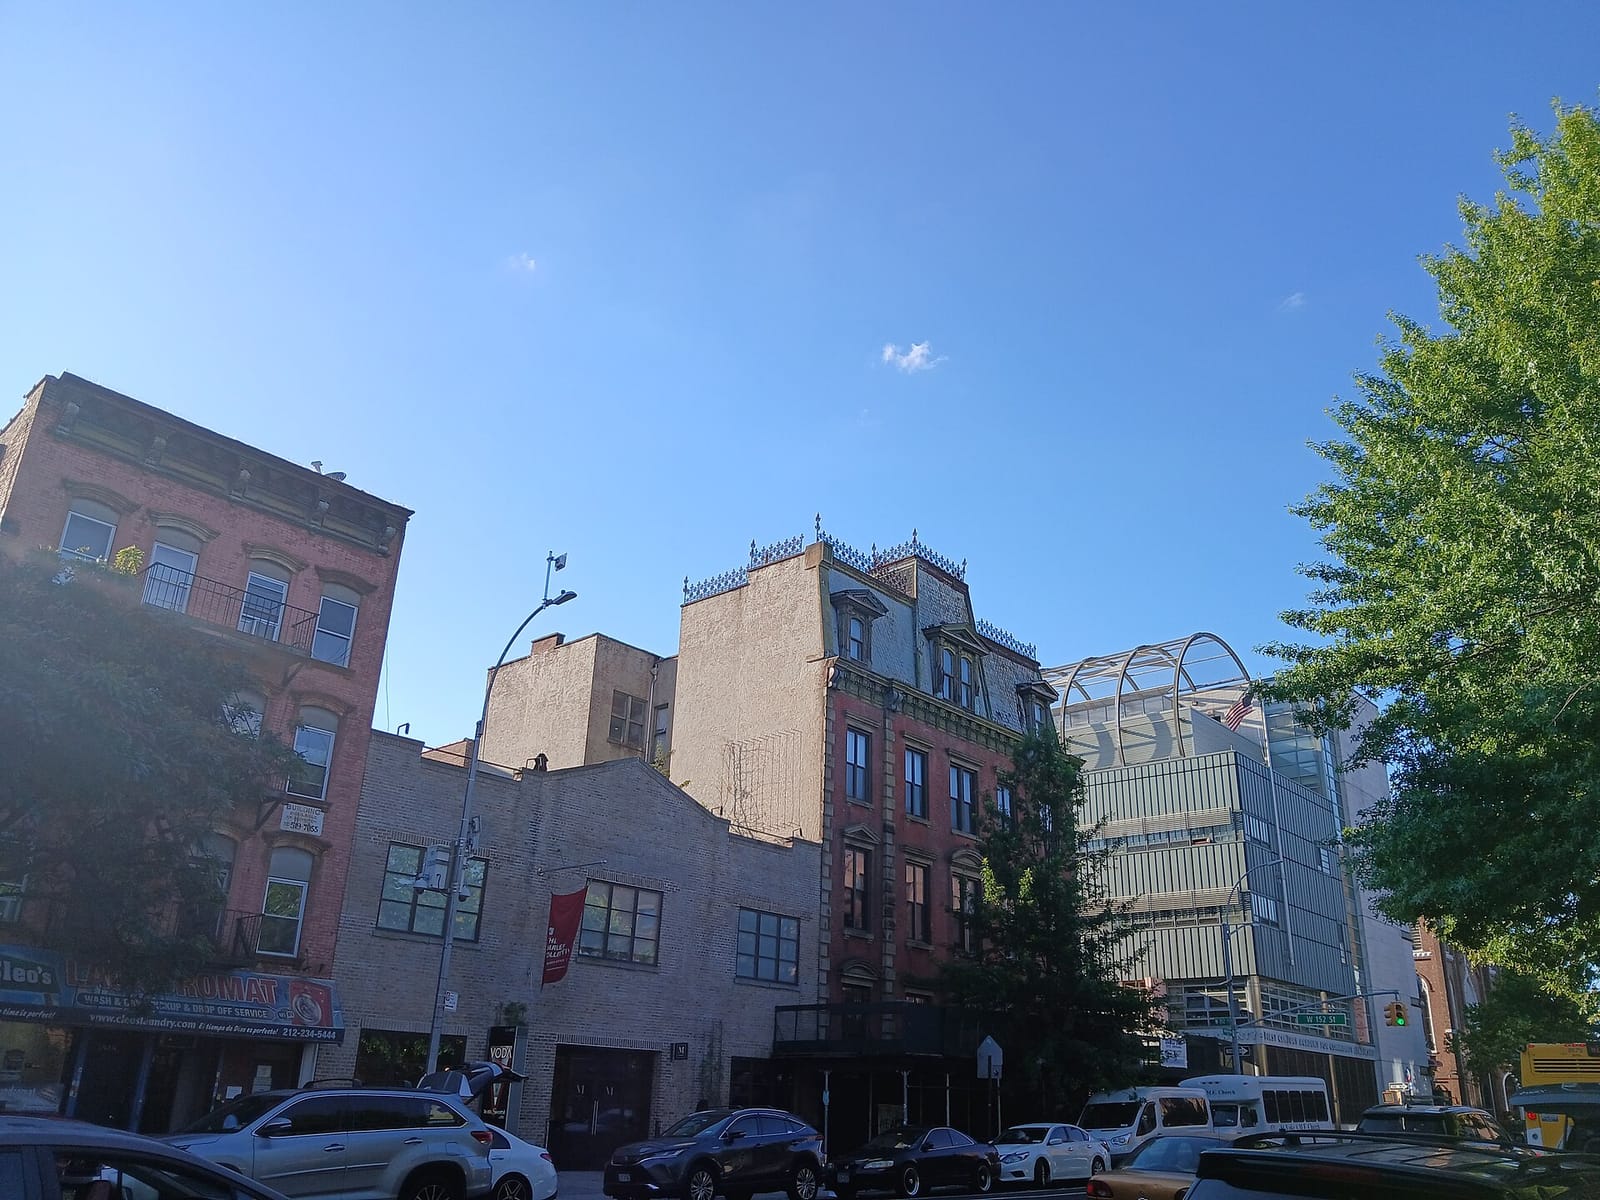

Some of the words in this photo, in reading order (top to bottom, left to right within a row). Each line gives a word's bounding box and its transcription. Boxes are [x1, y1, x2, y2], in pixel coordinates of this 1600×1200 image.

[0, 960, 52, 985] leo's
[193, 1004, 215, 1013] DROP
[218, 1006, 233, 1015] OFF
[235, 1007, 268, 1018] SERVICE
[1306, 1015, 1313, 1023] W
[1315, 1015, 1326, 1023] 152
[1328, 1015, 1336, 1023] St
[282, 1027, 336, 1040] 212-234-5444
